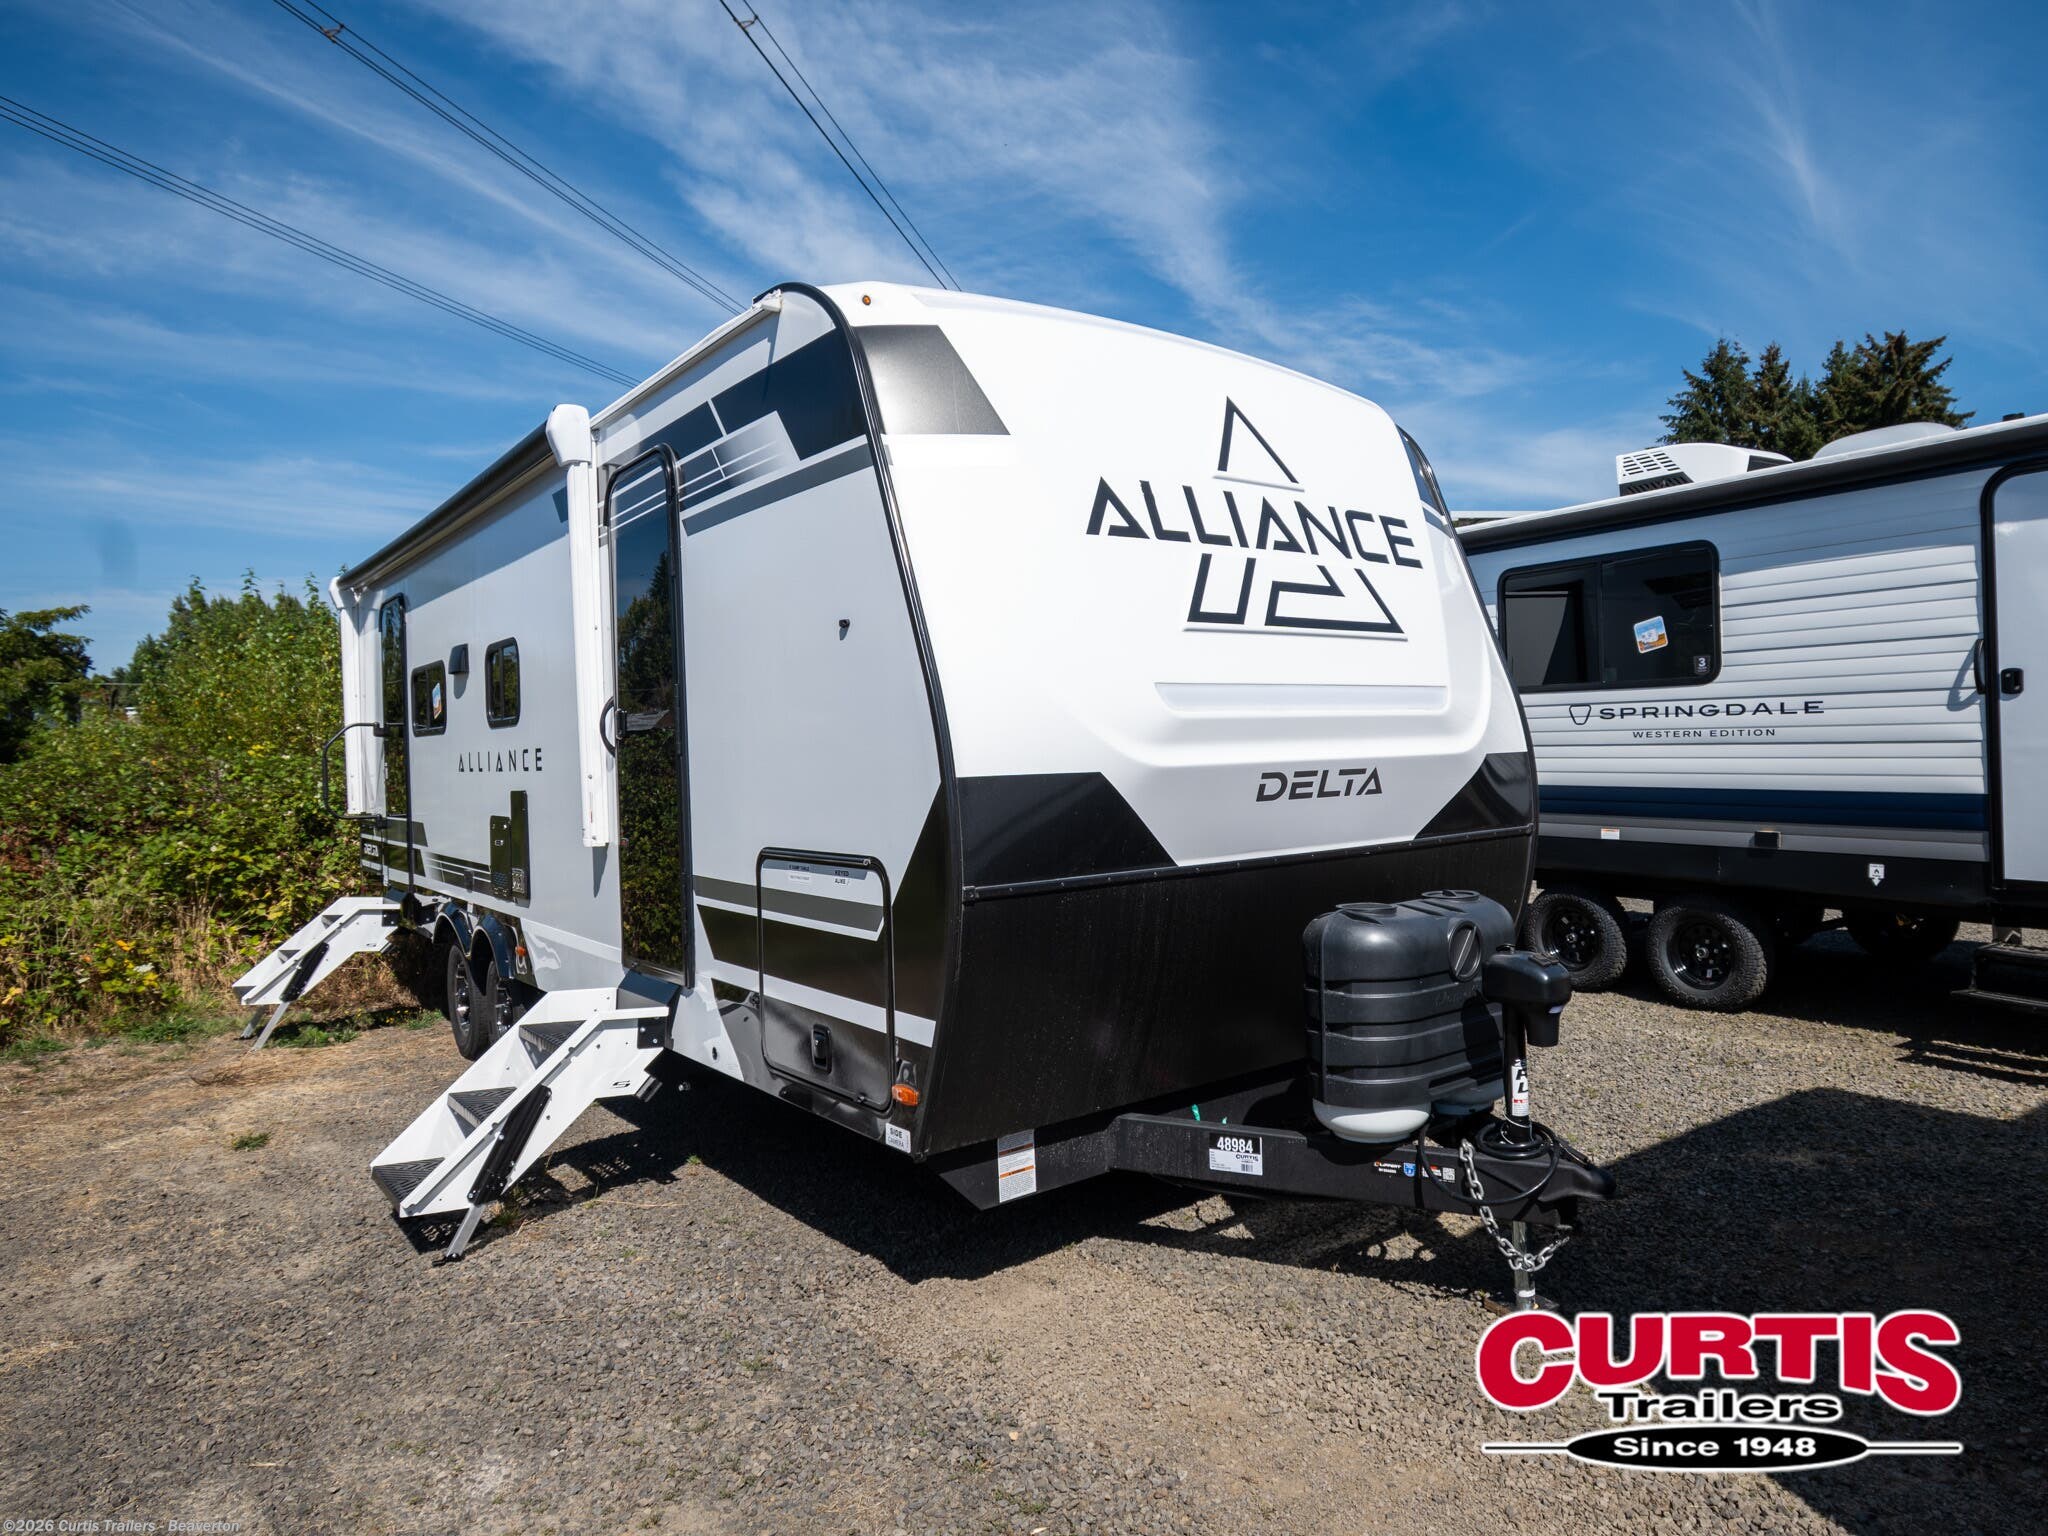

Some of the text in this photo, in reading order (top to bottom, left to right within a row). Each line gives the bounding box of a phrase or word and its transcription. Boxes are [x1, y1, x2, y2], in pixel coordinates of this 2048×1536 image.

[1086, 476, 1423, 569] ALLIANCE
[1698, 657, 1706, 667] 3
[1599, 700, 1825, 720] SPRINGDALE
[1632, 728, 1776, 739] WESTERN EDITION
[458, 747, 543, 773] ALLIANCE
[1256, 766, 1383, 802] DELTA
[1217, 1136, 1253, 1153] 48984
